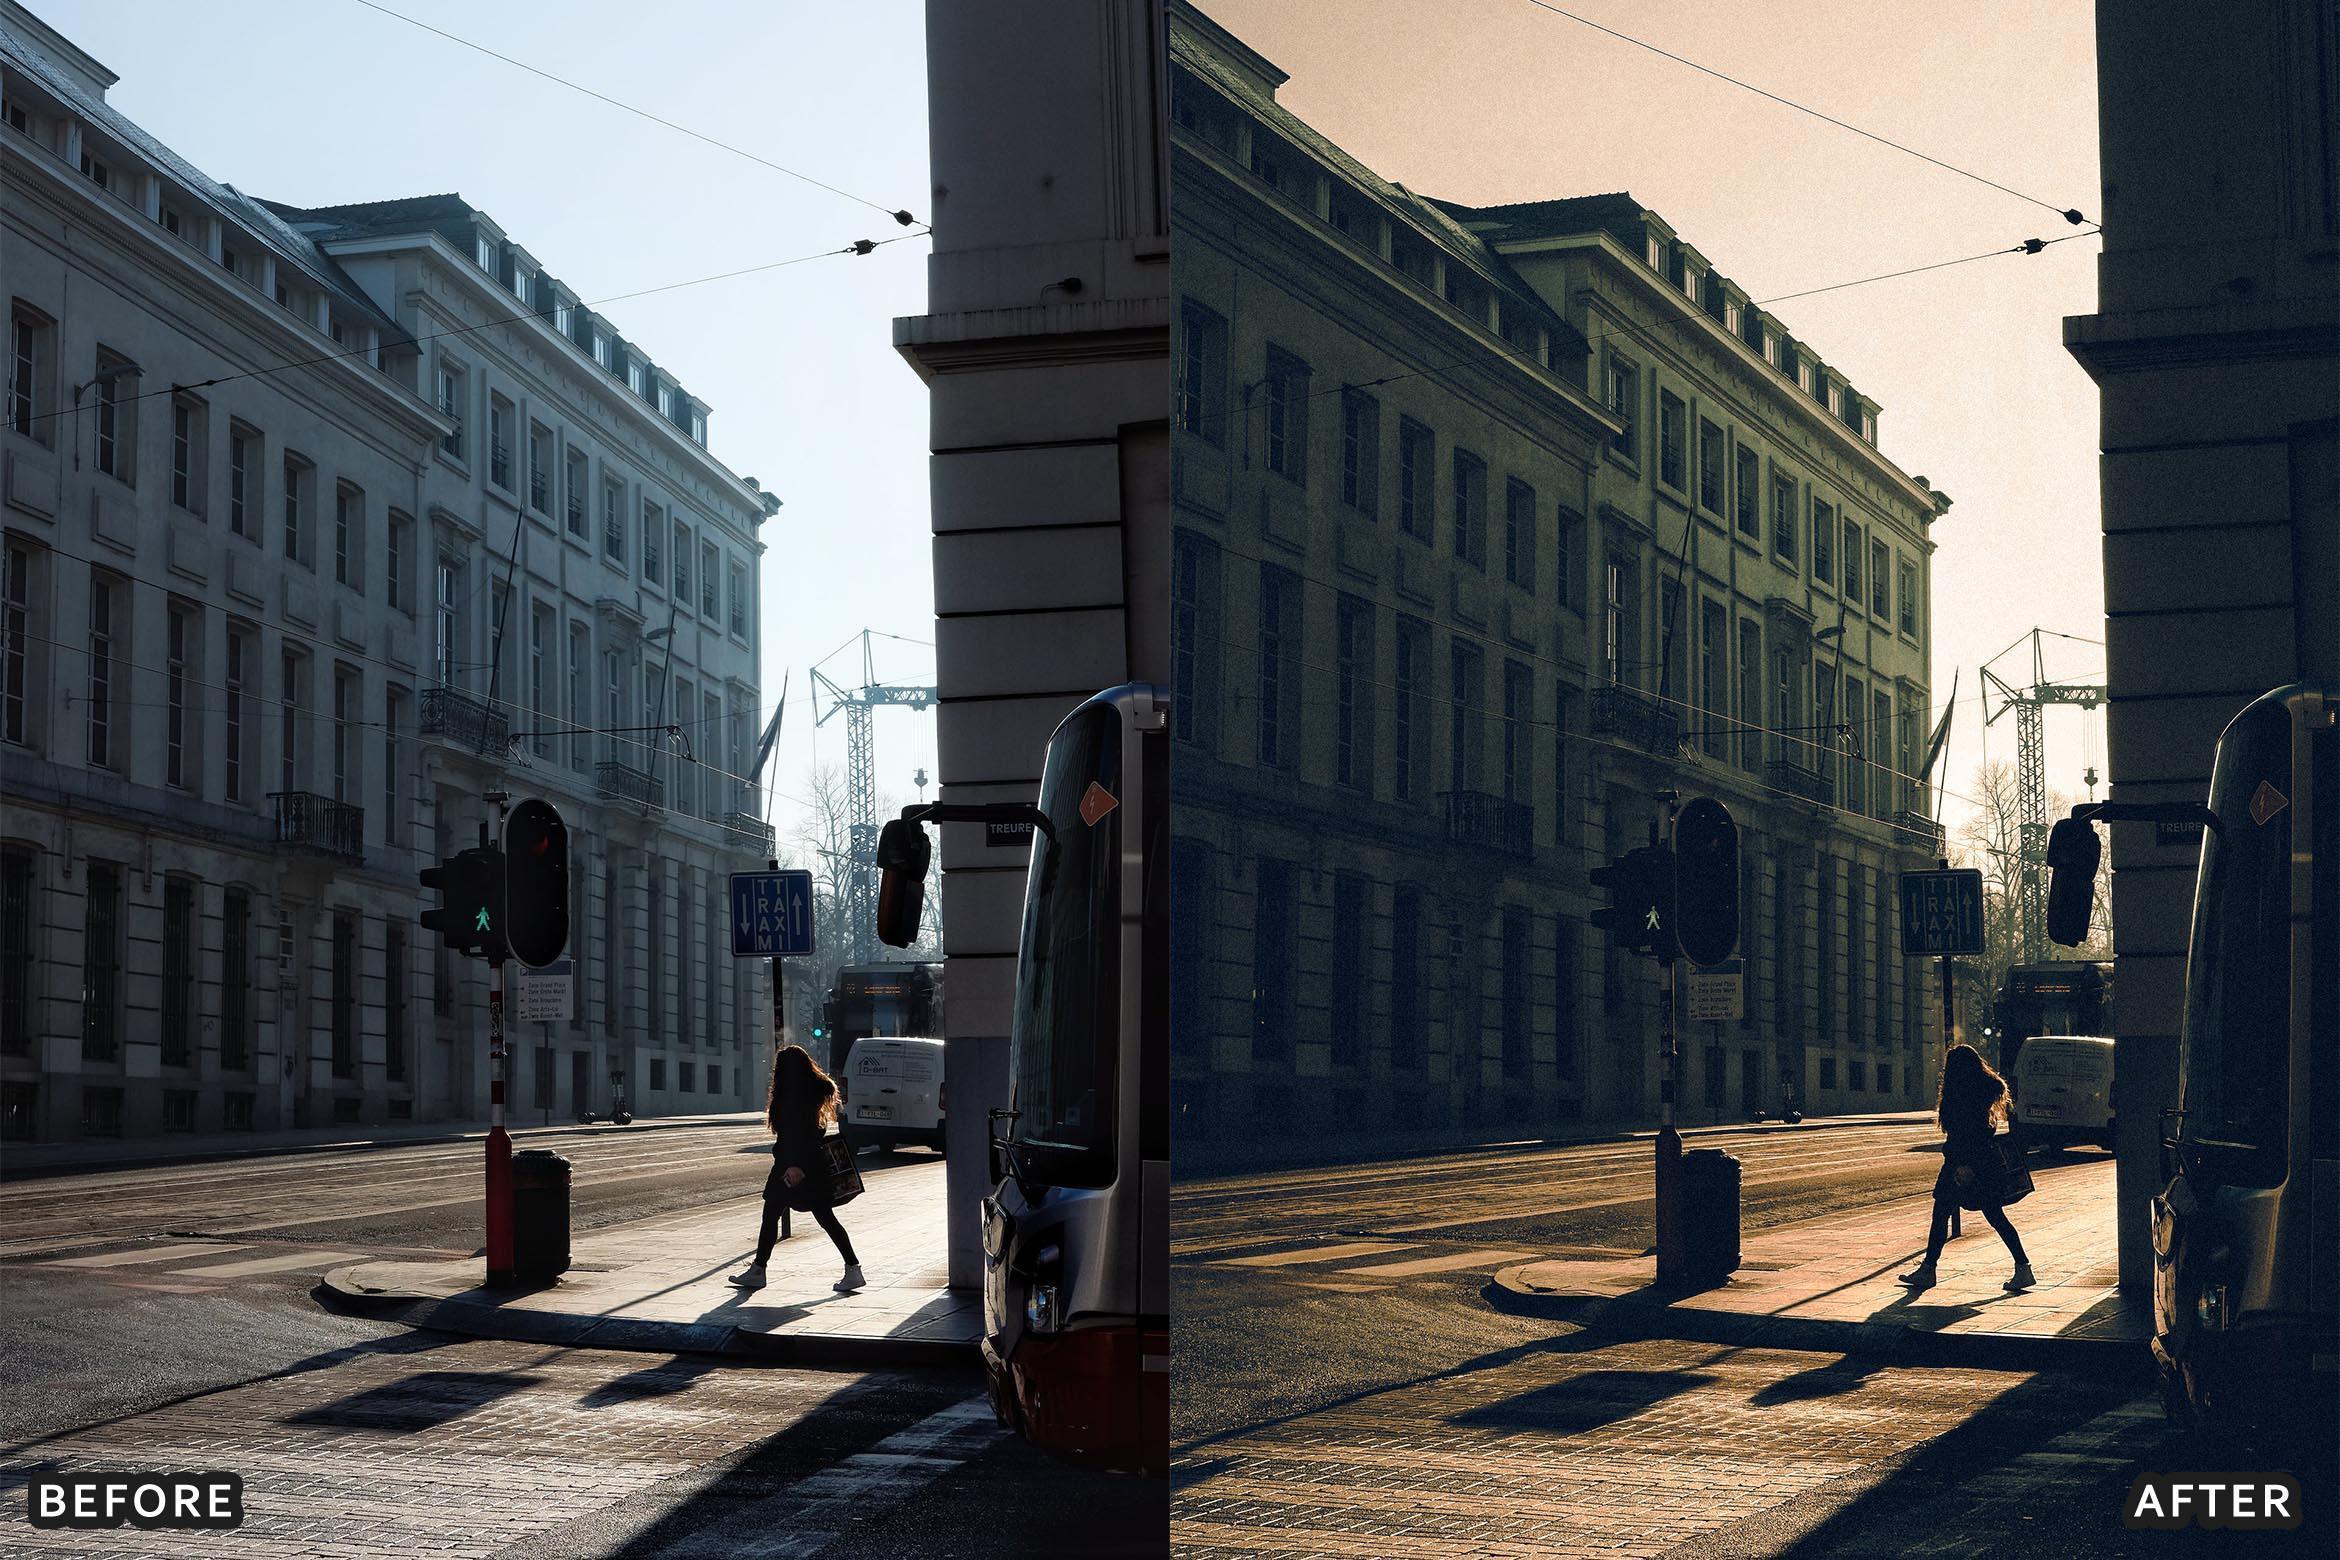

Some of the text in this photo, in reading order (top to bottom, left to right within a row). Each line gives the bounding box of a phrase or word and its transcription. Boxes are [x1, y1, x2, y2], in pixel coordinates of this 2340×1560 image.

[990, 822, 1034, 834] TREURE
[2160, 822, 2203, 833] TREURE
[757, 879, 772, 951] TRAM
[773, 879, 786, 951] TAXI
[1927, 878, 1942, 950] TRAM
[1943, 878, 1956, 950] TAXI
